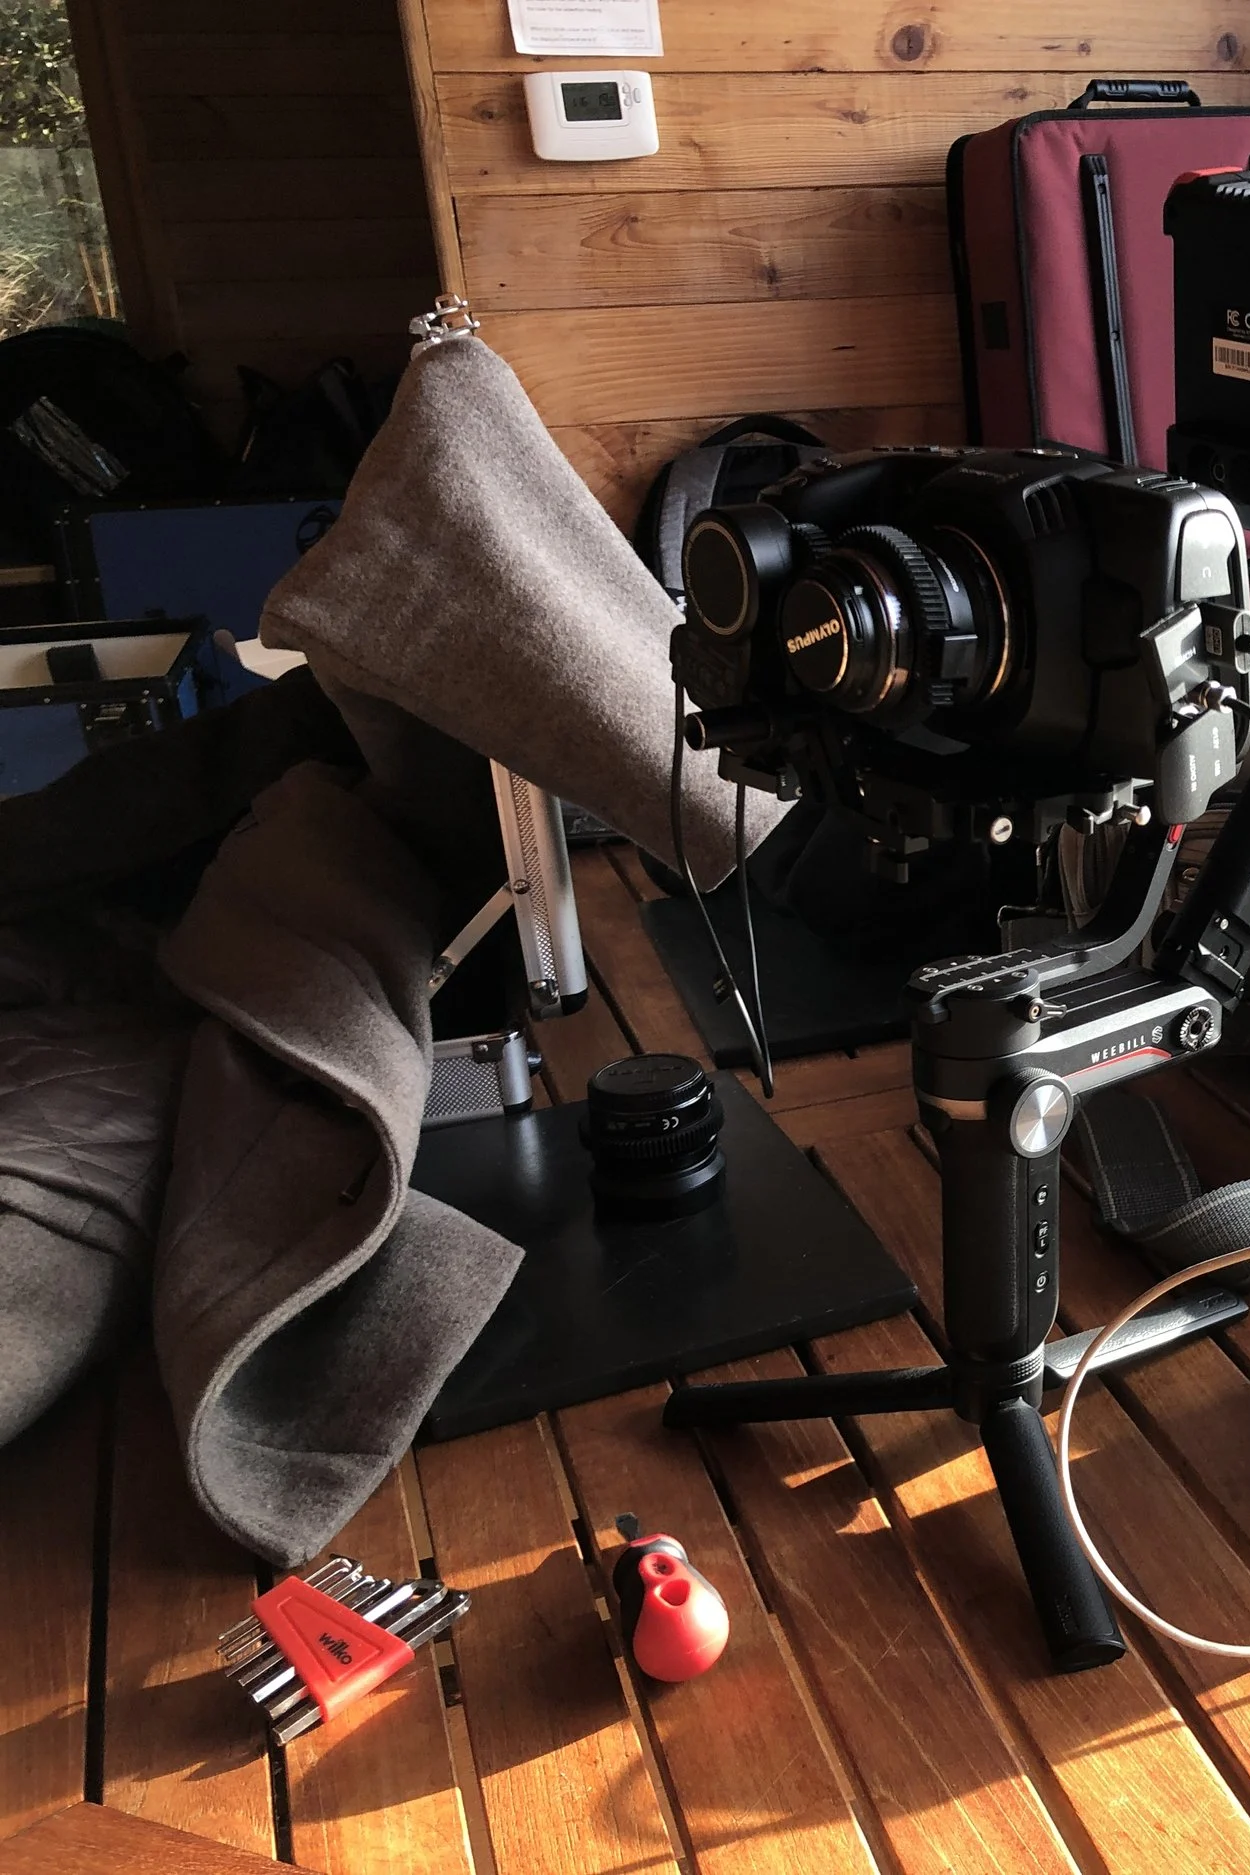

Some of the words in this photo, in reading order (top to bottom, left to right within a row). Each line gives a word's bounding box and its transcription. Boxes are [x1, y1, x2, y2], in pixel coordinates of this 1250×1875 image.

[787, 618, 840, 654] OLYMPUS
[1188, 754, 1198, 781] AUDIO
[1091, 1035, 1146, 1064] WEEBILL
[318, 1632, 353, 1665] wilko
